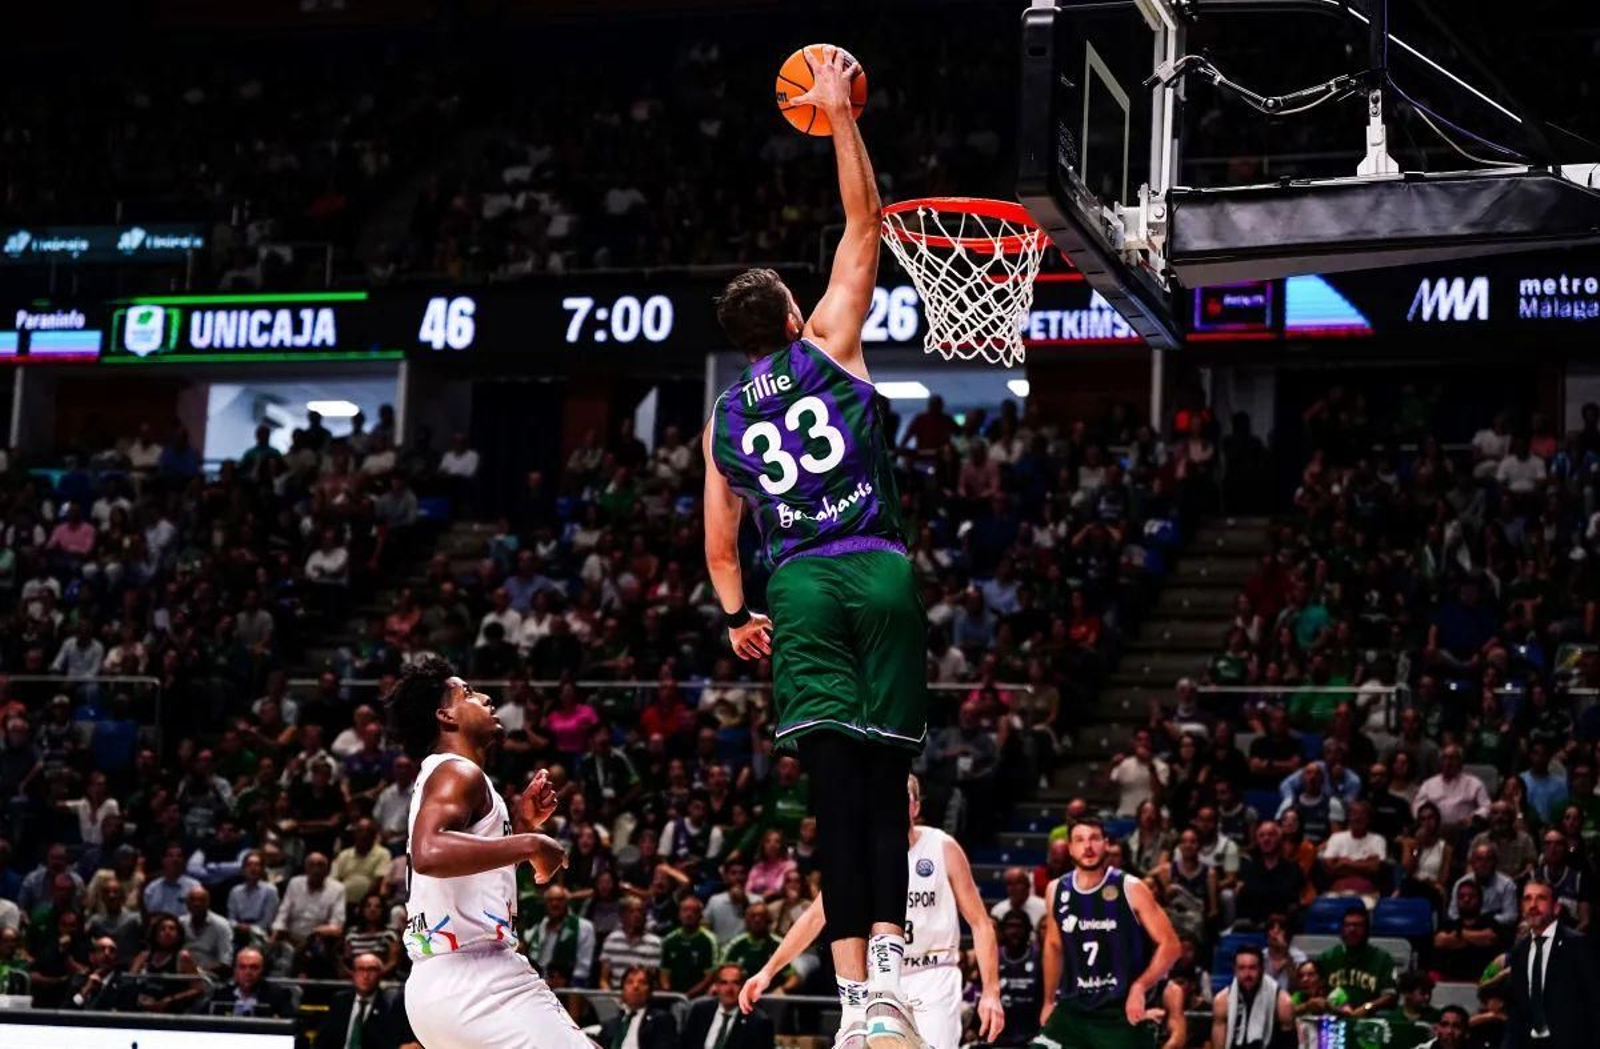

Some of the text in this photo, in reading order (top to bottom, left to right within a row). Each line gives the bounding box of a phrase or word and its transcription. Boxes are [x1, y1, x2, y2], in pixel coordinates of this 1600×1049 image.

[1519, 273, 1598, 296] metro
[15, 309, 86, 331] Paraninfo
[190, 308, 336, 348] UNICAJA
[419, 297, 475, 350] 46
[563, 295, 673, 342] 7:00
[861, 287, 917, 341] 26
[1020, 309, 1139, 340] PETKIMS
[742, 373, 793, 407] Tillie
[742, 396, 846, 495] 33
[908, 891, 936, 908] SPOR
[1078, 919, 1118, 932] Unicaja
[1082, 941, 1099, 967] 7
